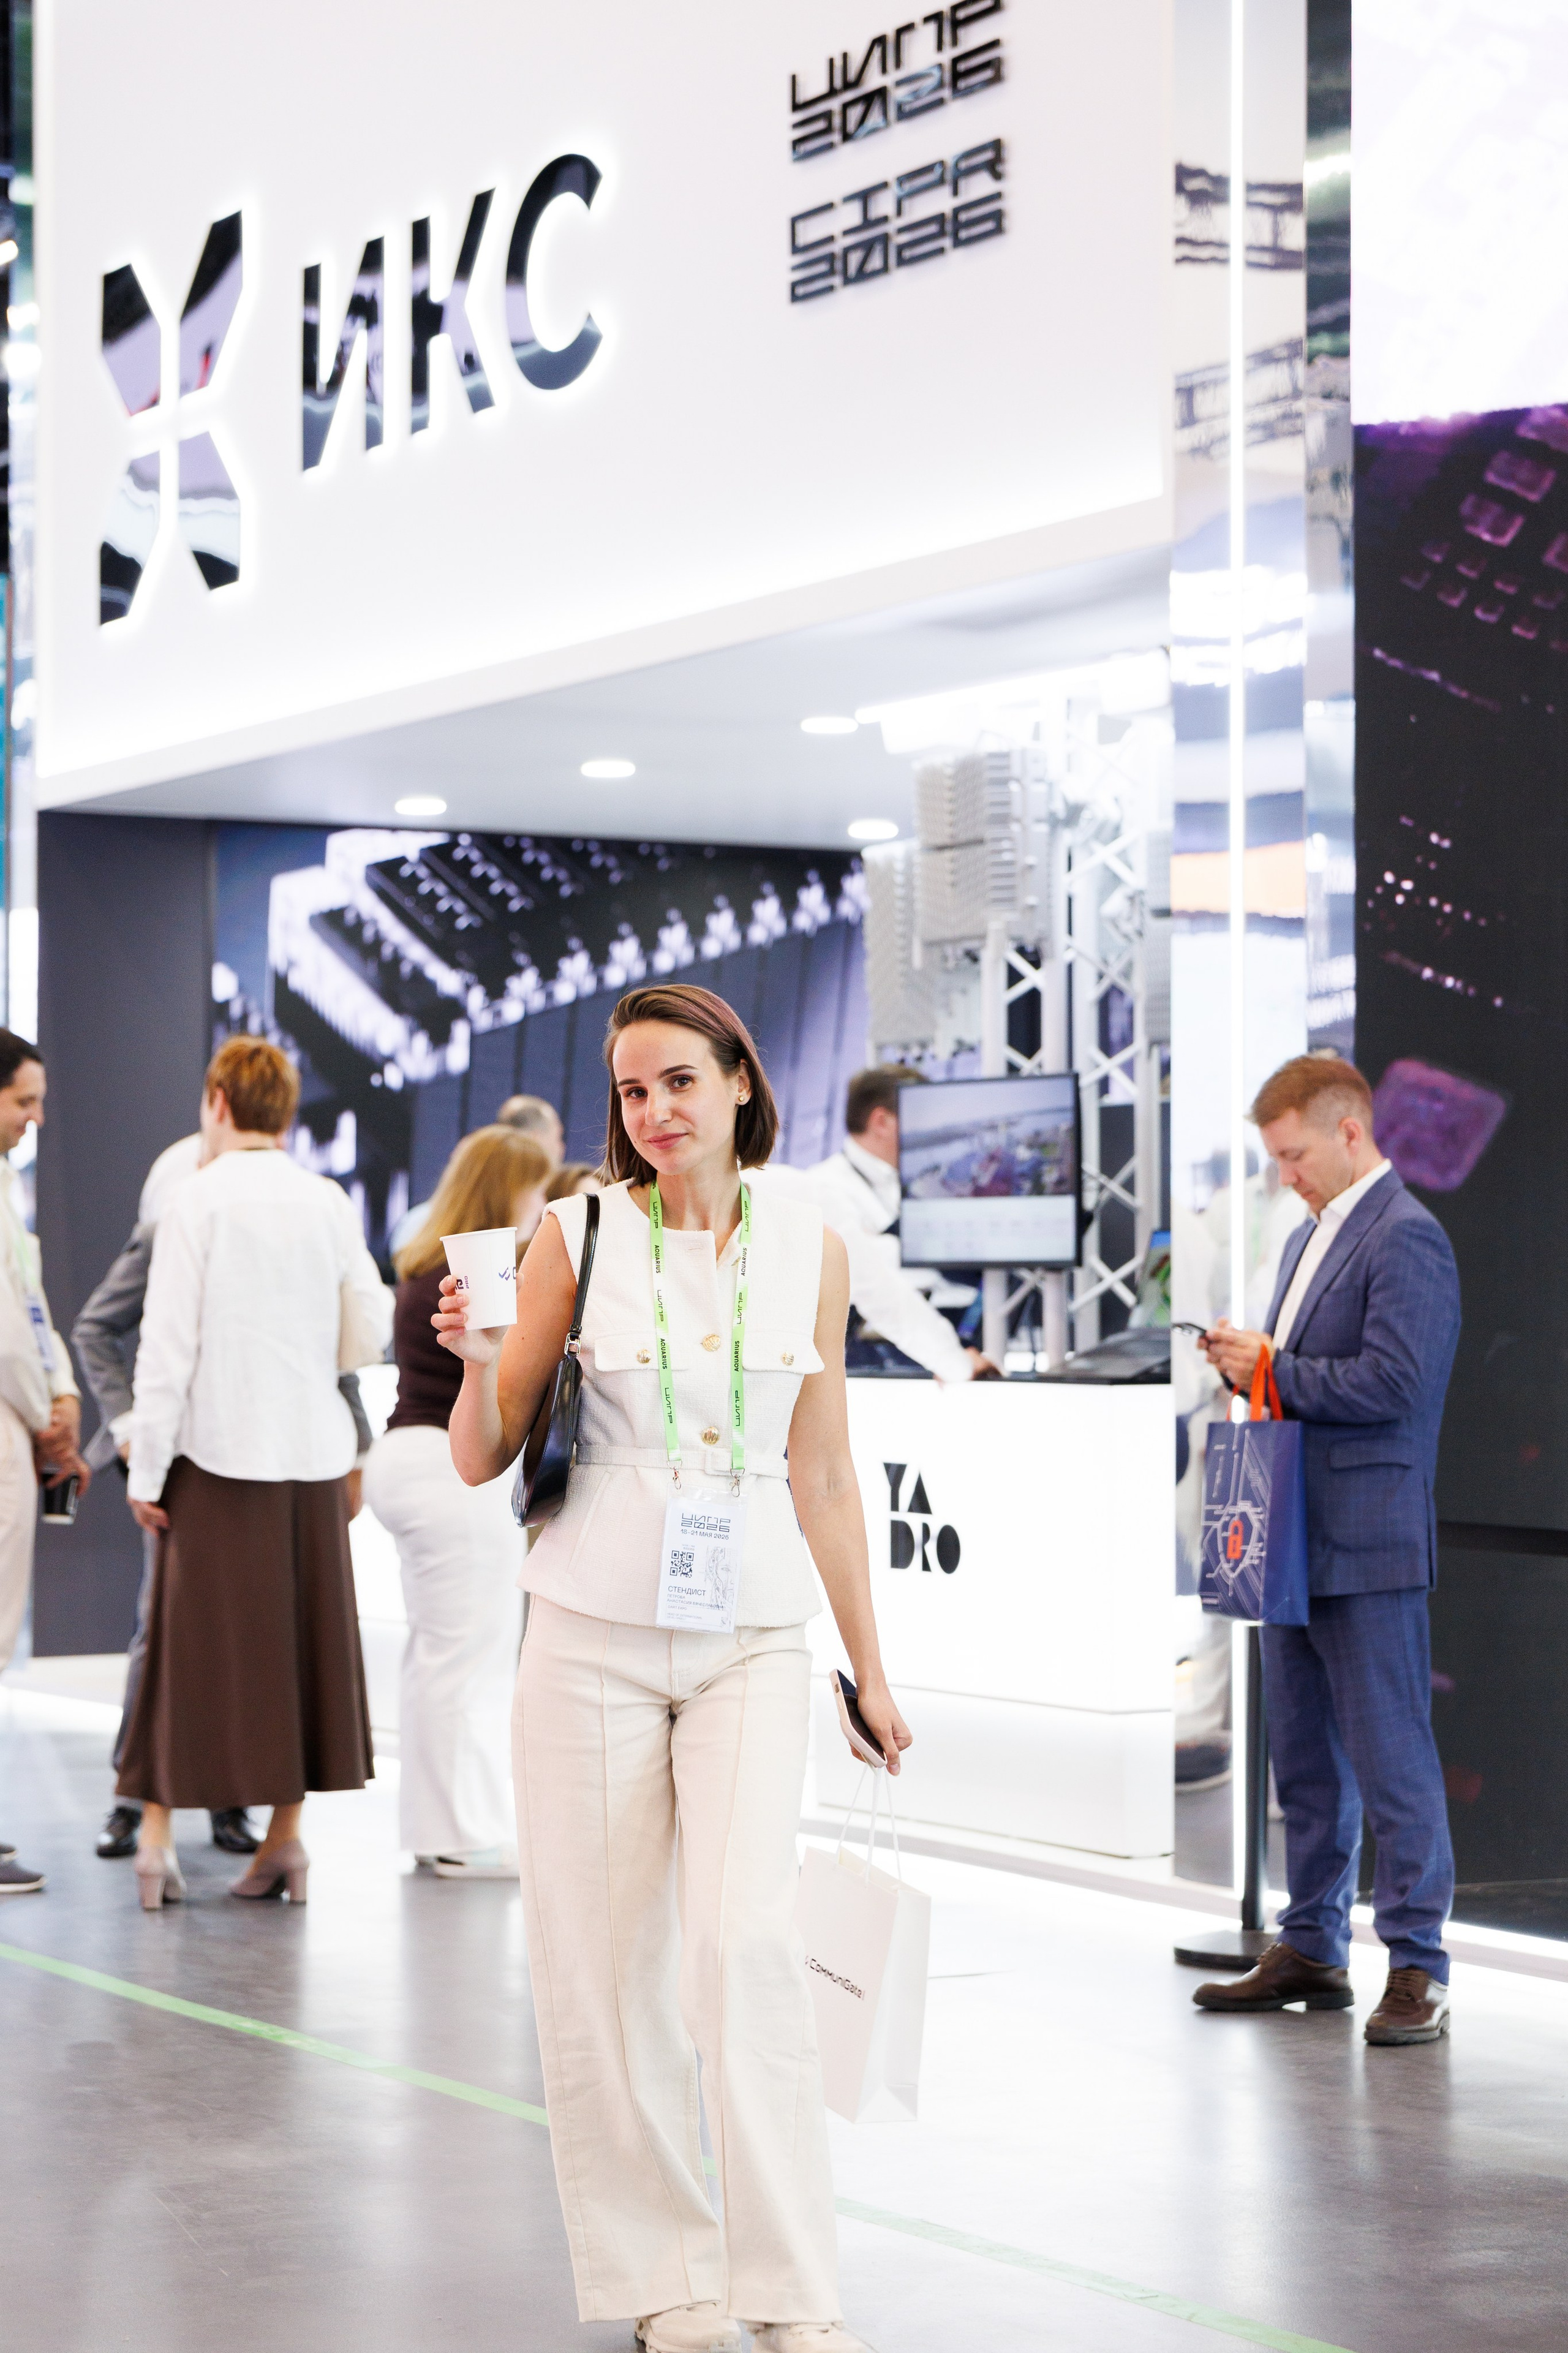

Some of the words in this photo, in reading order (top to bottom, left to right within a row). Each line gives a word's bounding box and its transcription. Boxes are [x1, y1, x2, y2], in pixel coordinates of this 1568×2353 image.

[792, 39, 1005, 162] 2026
[791, 138, 1002, 255] CIPR
[791, 192, 1005, 303] 2026
[303, 153, 603, 472] ИКС
[681, 1520, 730, 1533] 2026
[883, 1462, 933, 1515] YA
[890, 1519, 960, 1574] DRO
[668, 1585, 706, 1596] СТЕНДИСТ
